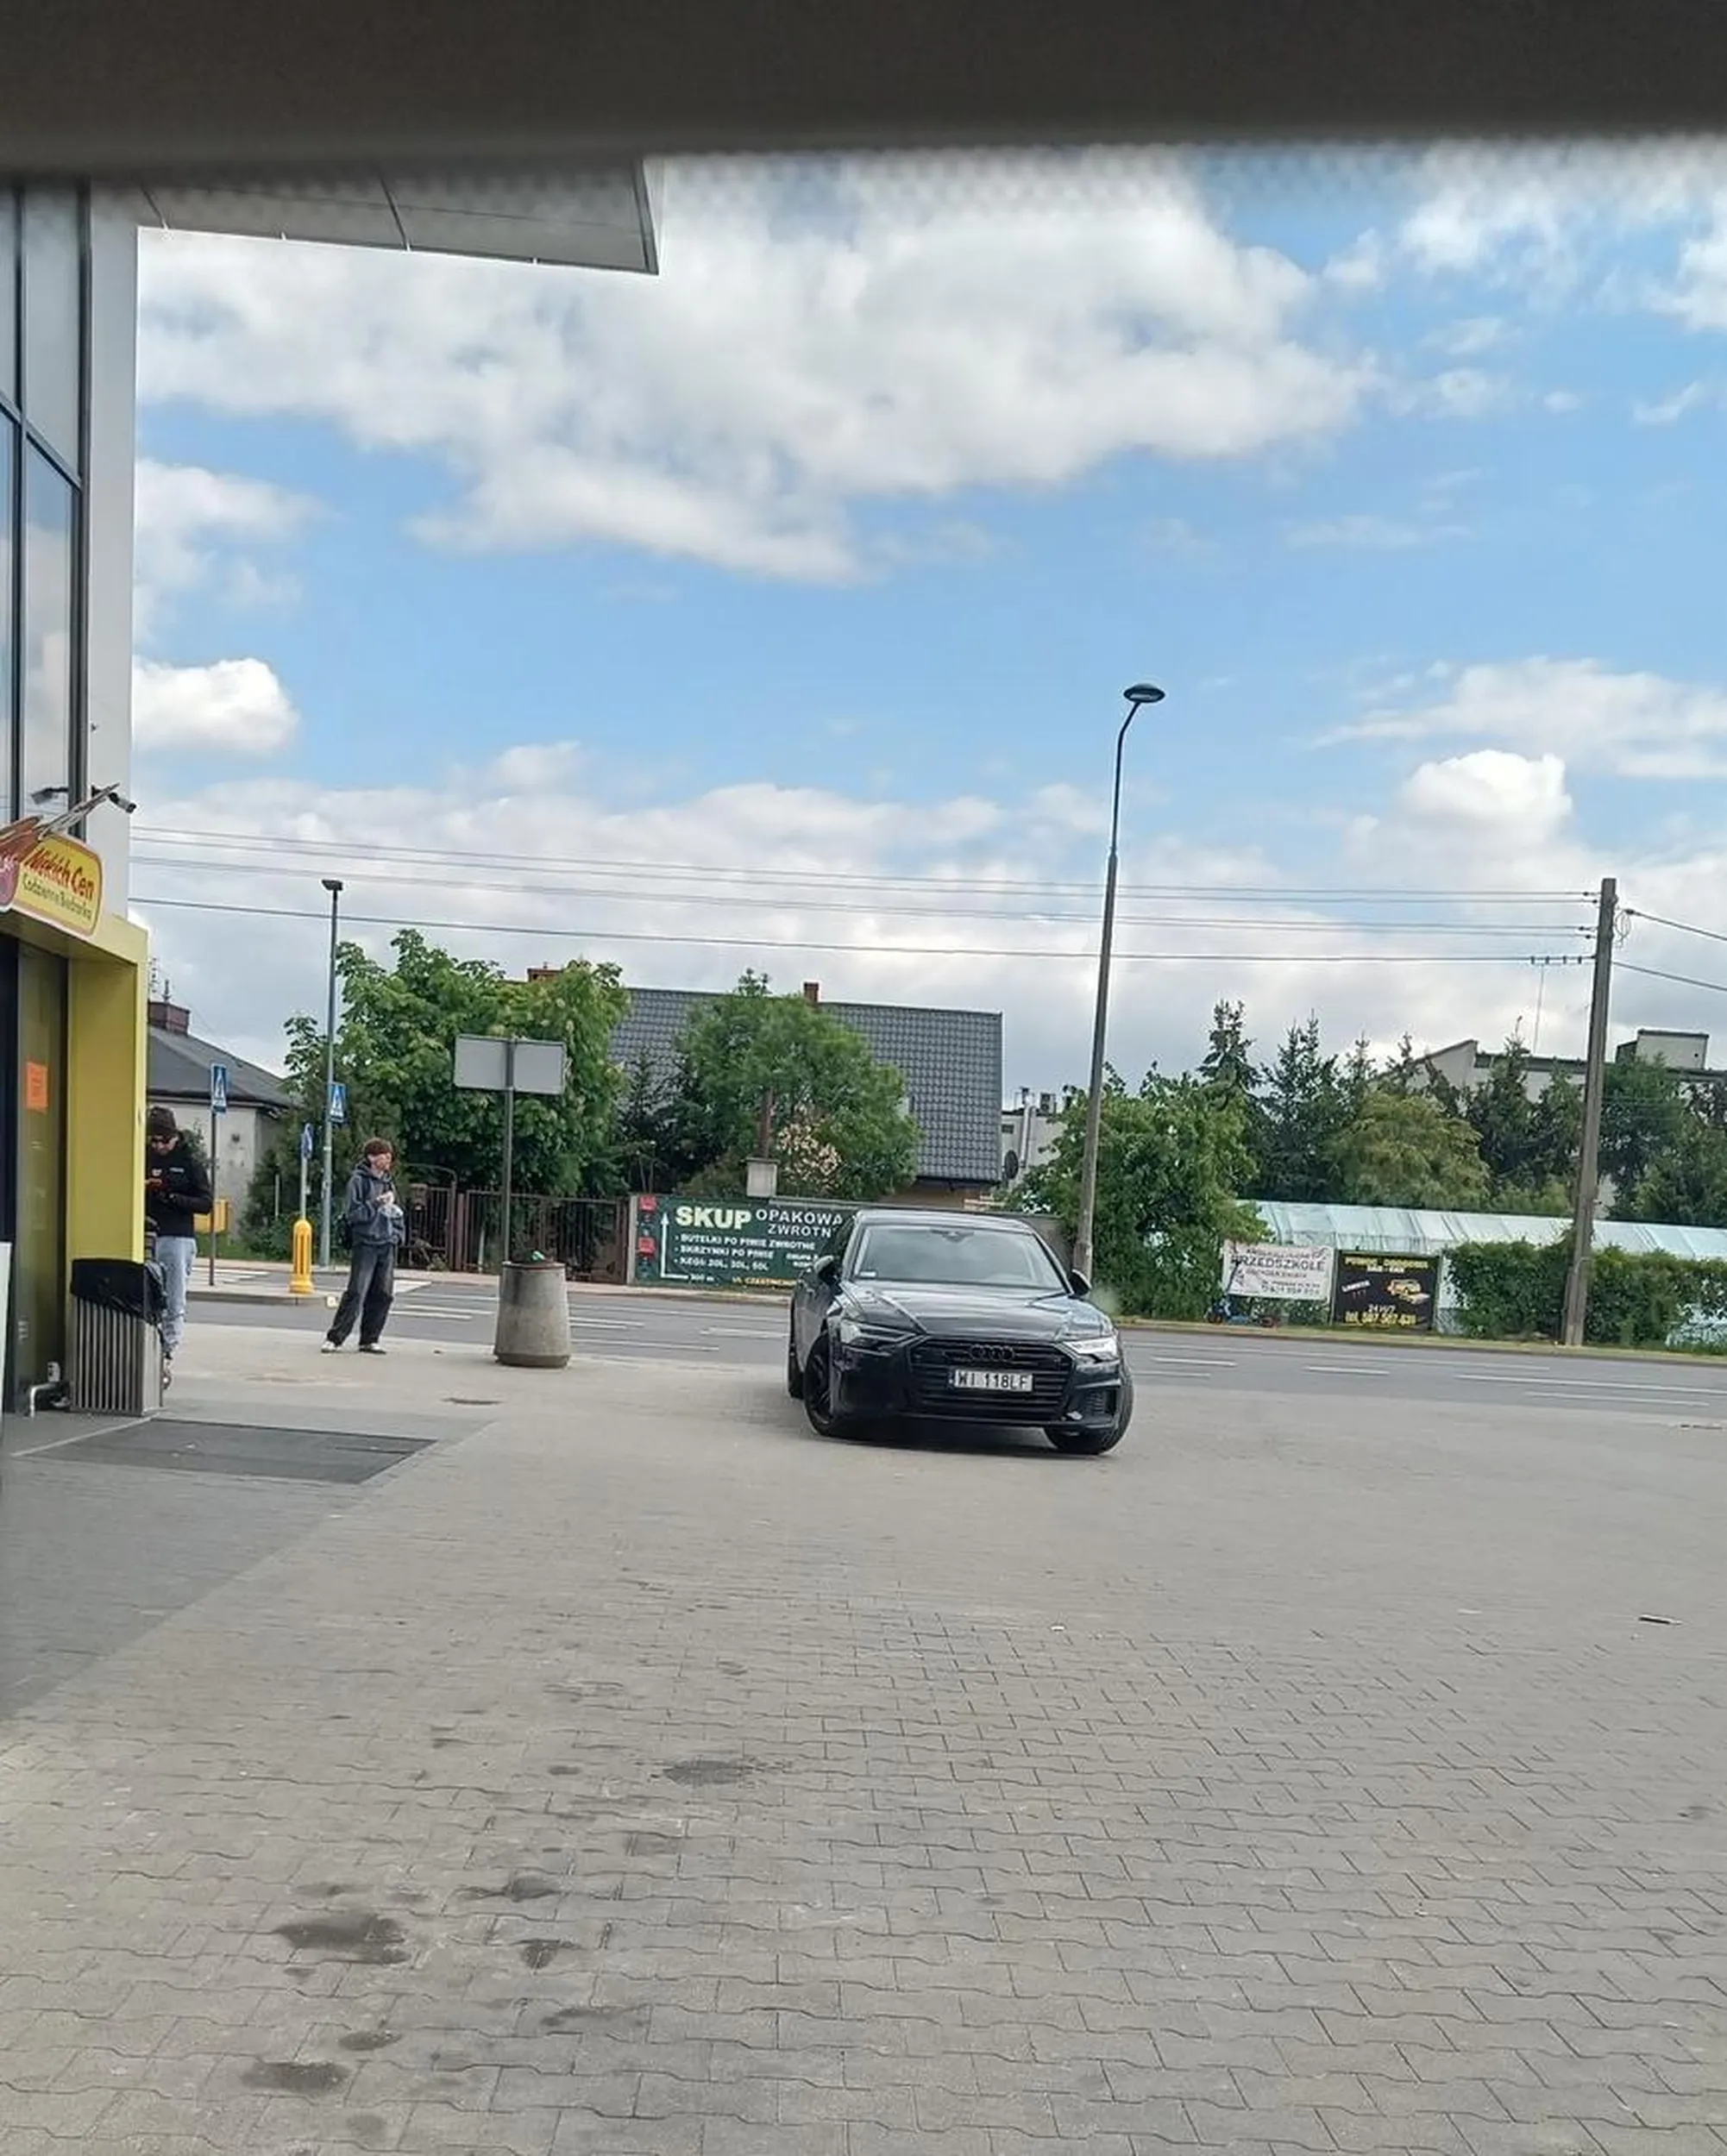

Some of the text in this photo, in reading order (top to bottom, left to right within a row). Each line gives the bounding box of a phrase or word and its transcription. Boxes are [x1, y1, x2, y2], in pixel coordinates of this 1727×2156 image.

[675, 1206, 843, 1230] SKUP OPAKOWA
[768, 1224, 835, 1238] ZWROTN
[769, 1239, 815, 1250] ZWROTNE
[732, 1248, 745, 1257] PO
[1231, 1255, 1325, 1272] PRZEDSZKOLE
[958, 1372, 1028, 1390] WI 118LF
